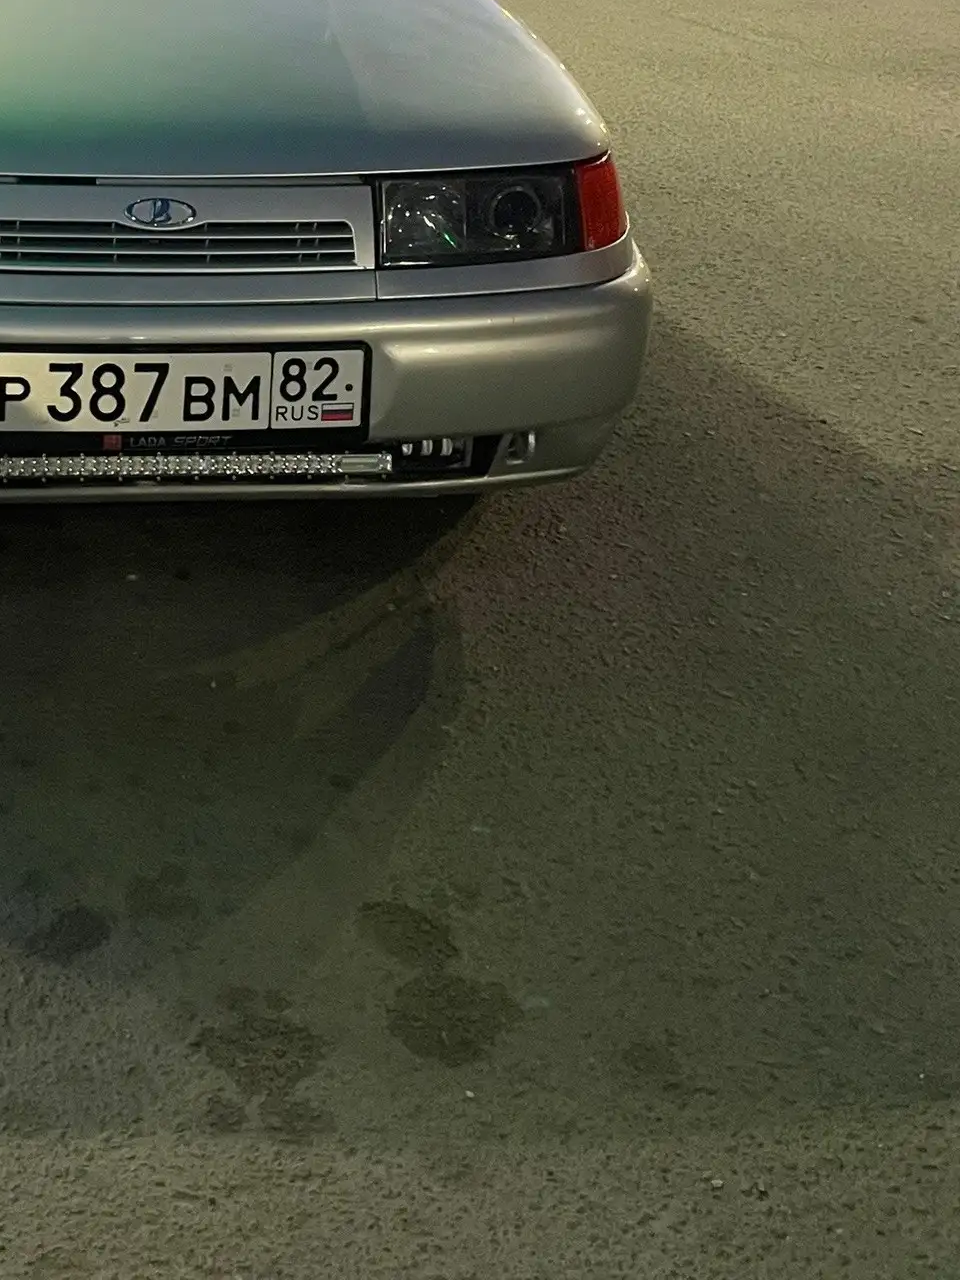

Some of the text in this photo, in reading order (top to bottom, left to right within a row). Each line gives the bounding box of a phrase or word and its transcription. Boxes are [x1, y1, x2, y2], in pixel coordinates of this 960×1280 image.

[279, 357, 339, 402] 82
[275, 405, 319, 421] RUS
[129, 435, 233, 448] LADA SPORT
